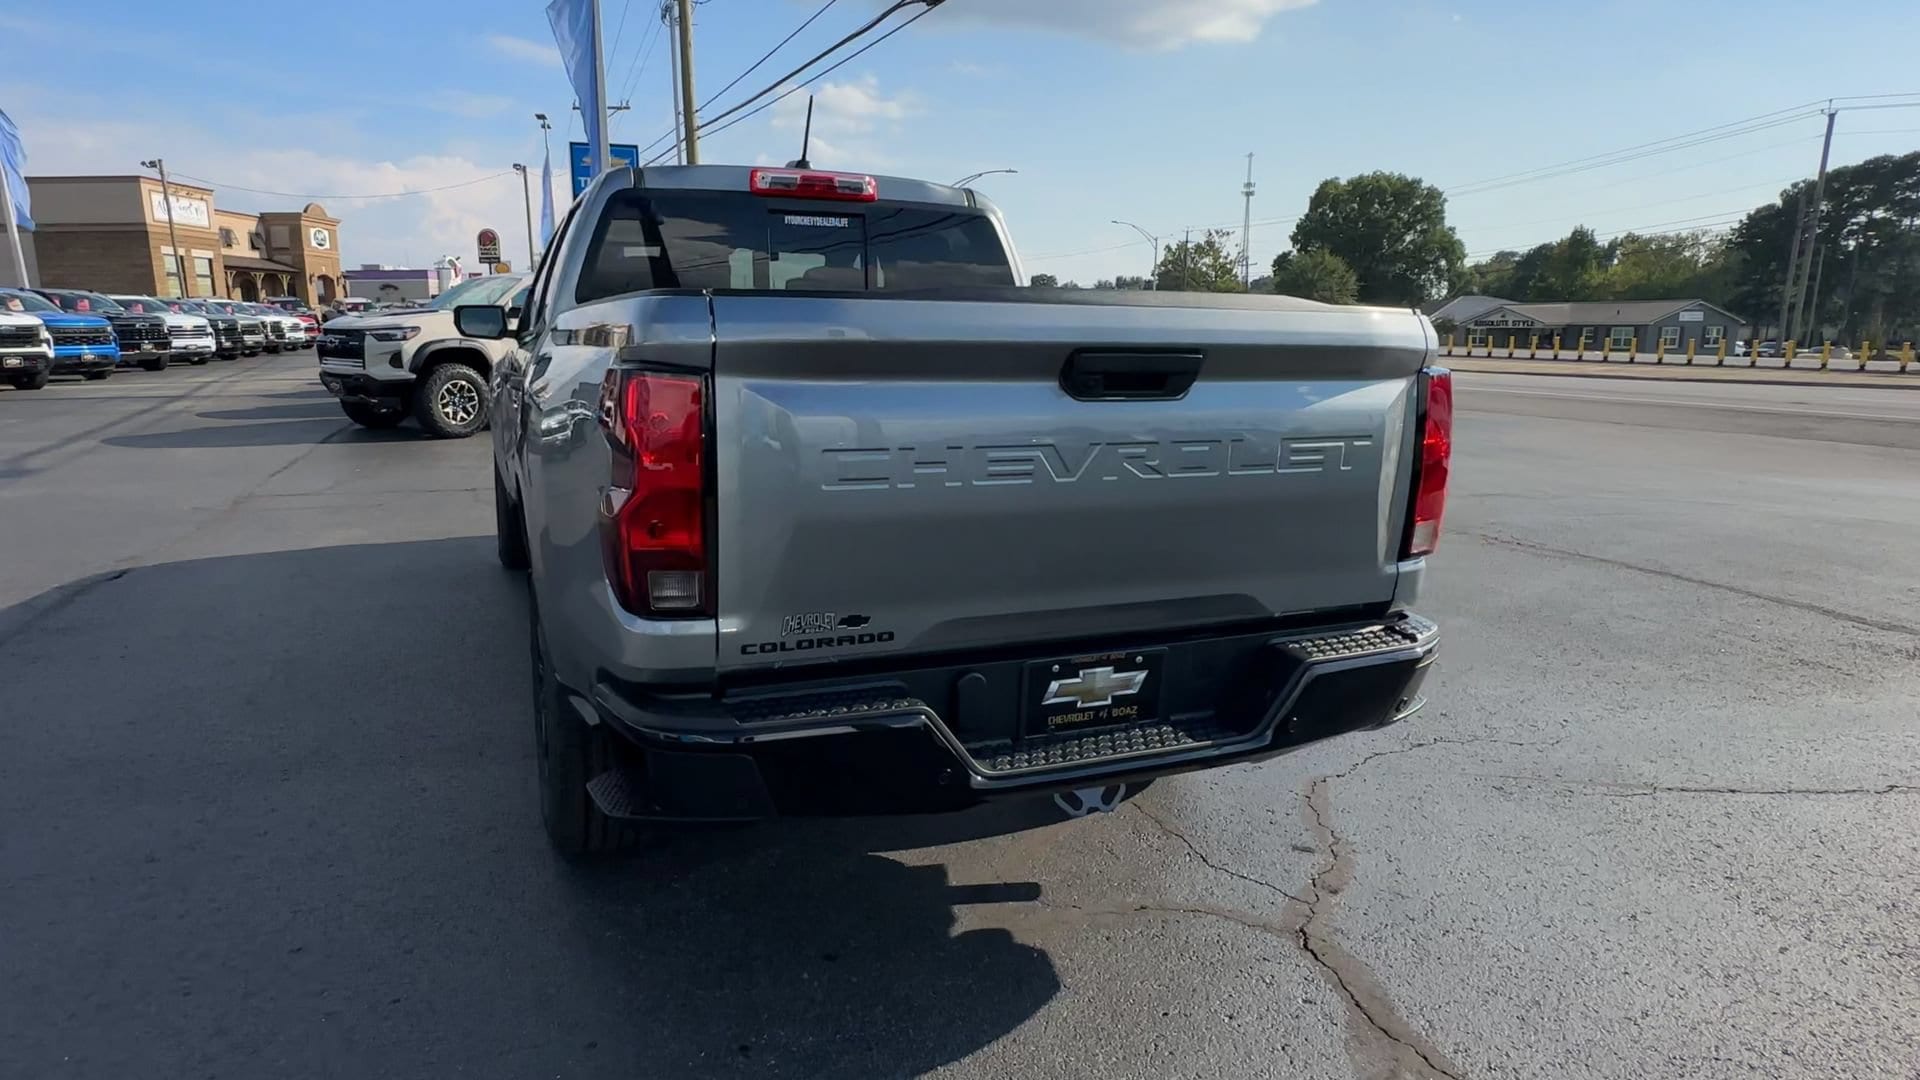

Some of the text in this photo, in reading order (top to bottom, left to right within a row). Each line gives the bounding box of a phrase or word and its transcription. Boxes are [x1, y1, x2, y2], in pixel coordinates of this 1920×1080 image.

[1511, 319, 1536, 327] STYLE
[821, 434, 1374, 491] CHEVROLET
[782, 612, 836, 637] CHEVROLET
[740, 630, 895, 655] COLORADO
[1047, 711, 1095, 726] CHEVROLET
[1111, 705, 1138, 717] BOAZ
